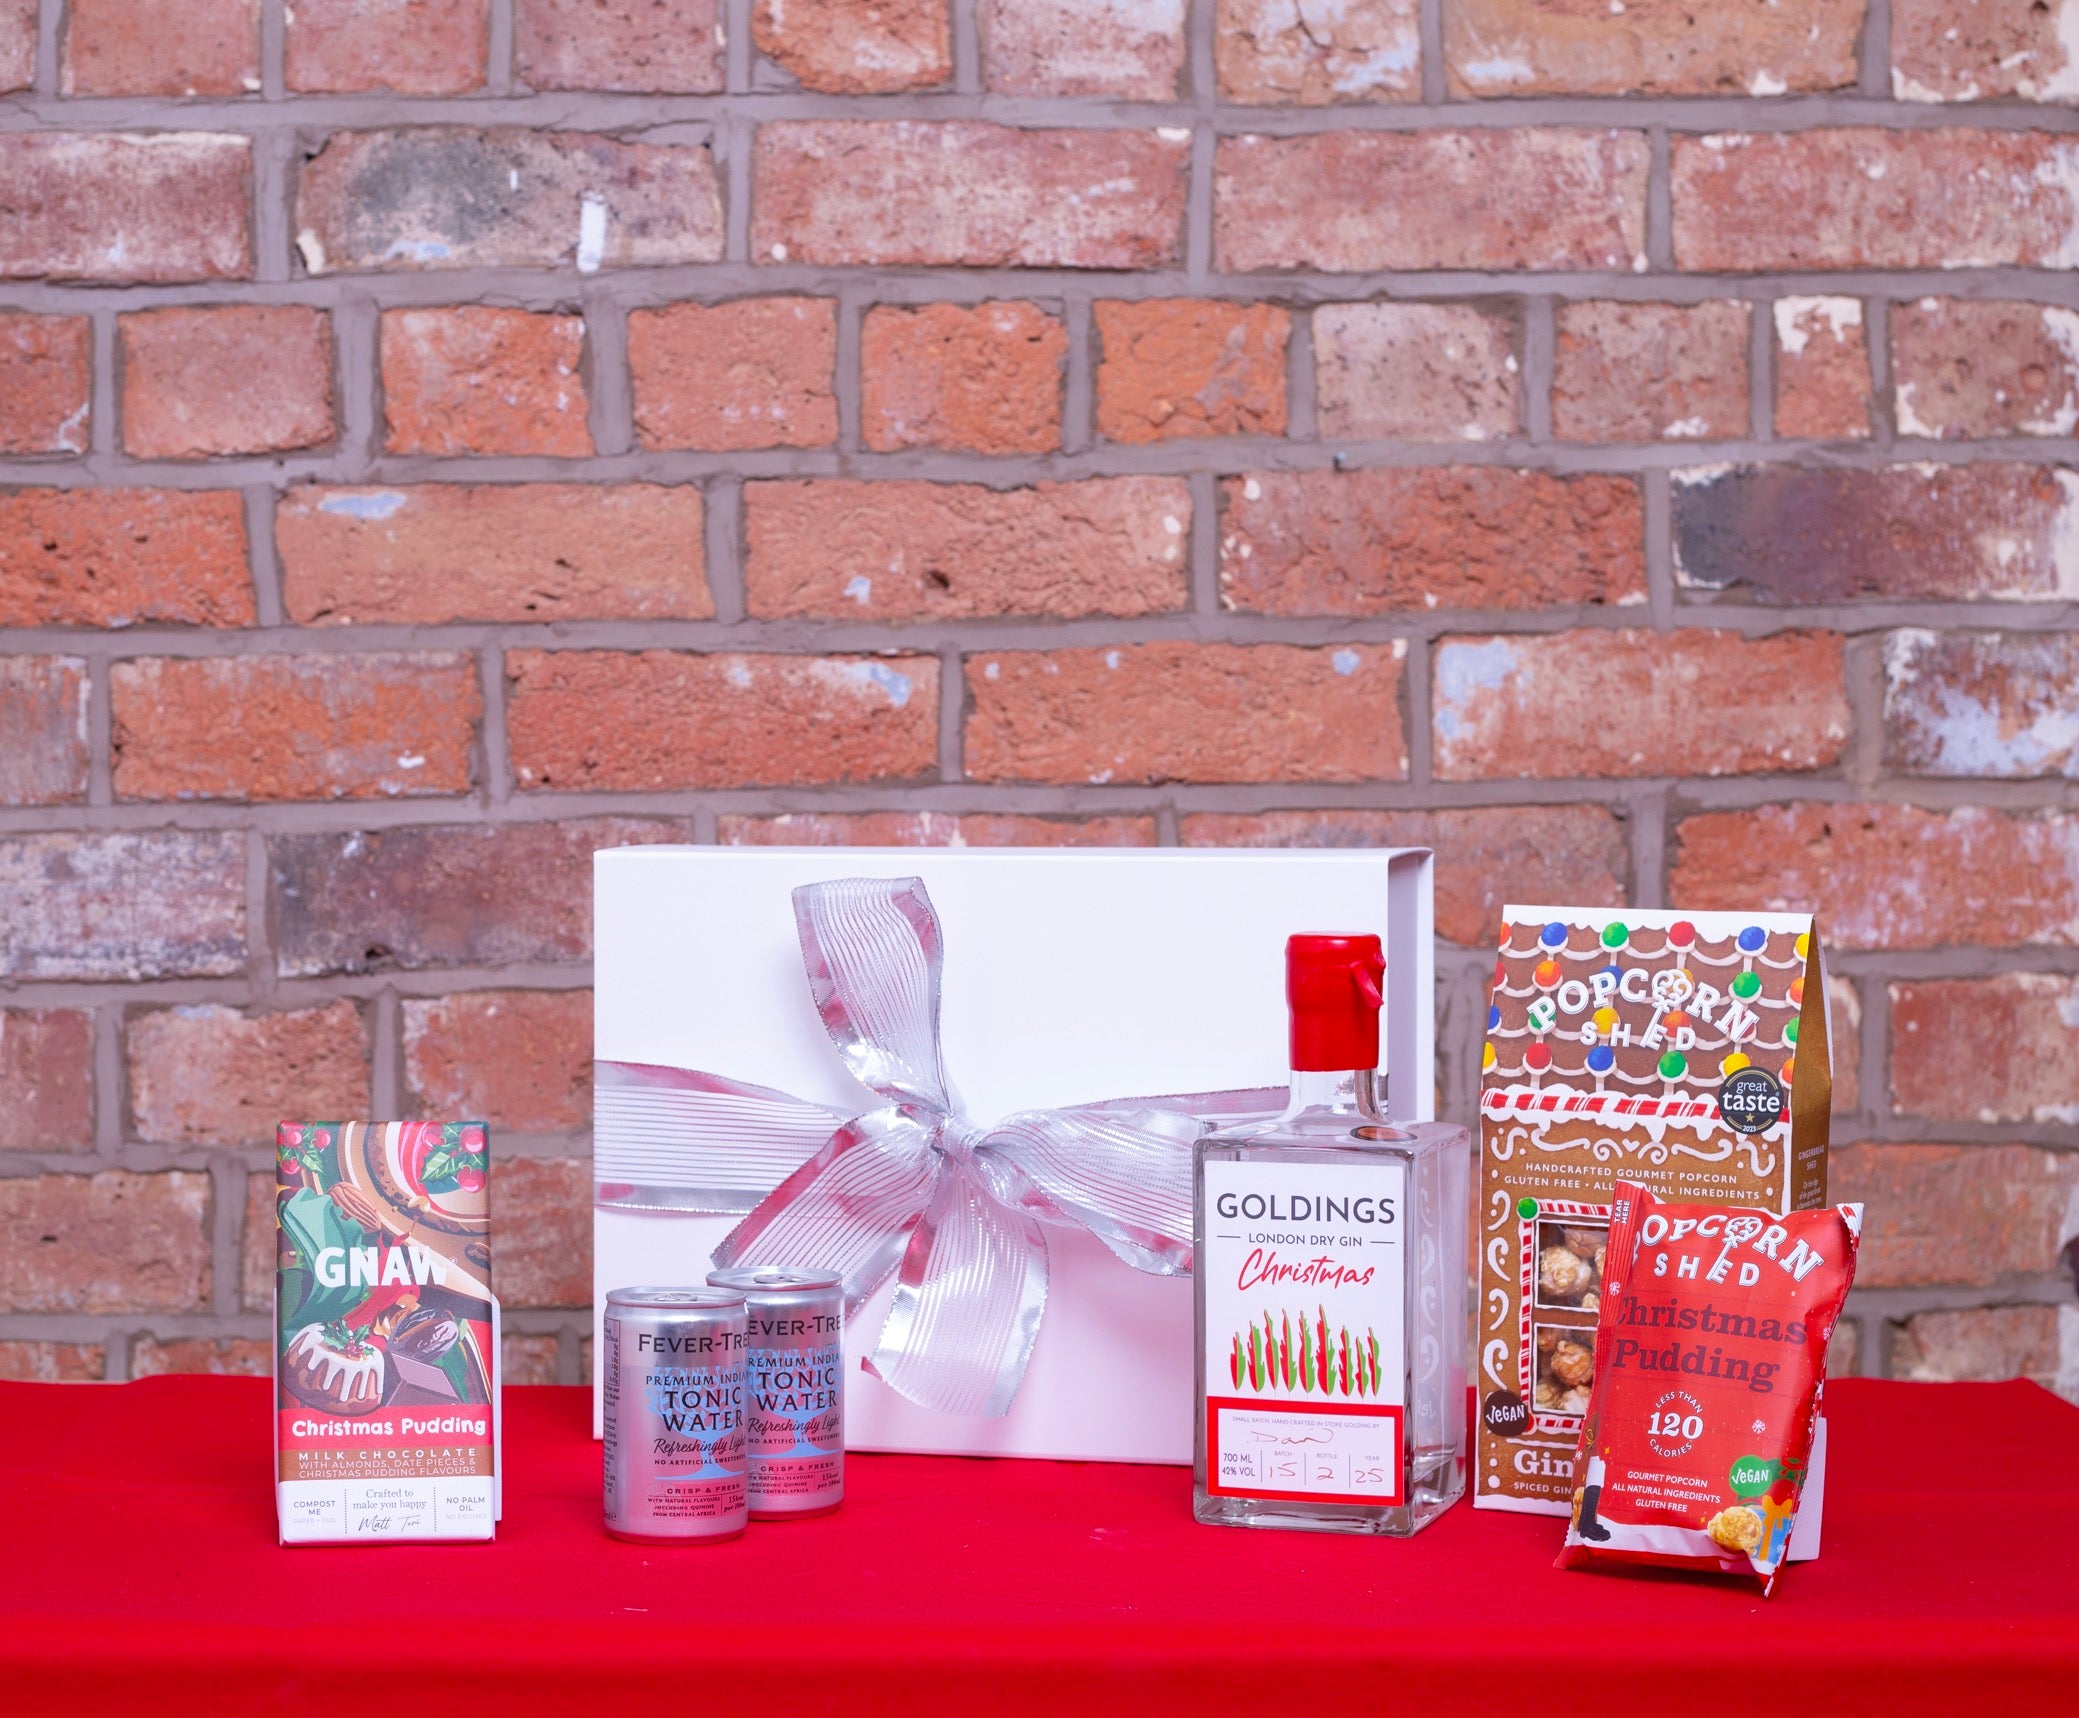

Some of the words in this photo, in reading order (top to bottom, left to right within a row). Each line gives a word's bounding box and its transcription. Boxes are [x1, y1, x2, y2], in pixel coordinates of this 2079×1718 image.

[1526, 967, 1760, 1044] POPCORN
[1580, 1020, 1697, 1051] SHED
[1736, 1080, 1767, 1095] great
[1722, 1091, 1780, 1113] taste
[1742, 1124, 1757, 1133] 2023
[1526, 1163, 1612, 1176] HANDCRAFTED
[1616, 1167, 1674, 1180] GOURMET
[1679, 1172, 1737, 1184] POPCORN
[1504, 1176, 1549, 1186] GLUTEN
[1554, 1179, 1580, 1189] FREE
[1593, 1182, 1614, 1191] ALL
[1679, 1187, 1760, 1200] INGREDIENTS
[1216, 1193, 1396, 1225] GOLDINGS
[1614, 1200, 1623, 1223] TEAR
[1621, 1200, 1630, 1224] HERE
[1249, 1233, 1305, 1245] LONDON
[1310, 1235, 1335, 1246] DRY
[1339, 1236, 1362, 1247] GIN
[1633, 1214, 1824, 1282] OPCORN
[315, 1246, 447, 1288] GNAW
[1238, 1248, 1375, 1291] Christmas
[1654, 1252, 1760, 1287] SHED
[638, 1332, 750, 1353] FEVER-TRE
[748, 1357, 806, 1367] REMIUM
[1612, 1339, 1780, 1393] Pudding
[646, 1375, 714, 1386] PREMIUM
[758, 1368, 834, 1389] TONIC
[664, 1386, 741, 1409] TONIC
[756, 1391, 837, 1411] WATER
[1656, 1392, 1675, 1408] LESS
[1679, 1391, 1703, 1413] THAN
[292, 1420, 394, 1437] Christmas
[401, 1417, 486, 1436] Pudding
[662, 1409, 743, 1432] WATER
[748, 1417, 820, 1436] Refreshingly
[1648, 1412, 1704, 1440] 120
[299, 1451, 345, 1460] MILK
[359, 1448, 476, 1459] CHOCOLATE
[654, 1437, 728, 1456] Refreshingly
[1650, 1439, 1692, 1457] CALORIES
[299, 1461, 328, 1469] WITH
[332, 1460, 390, 1469] ALMONDS,
[394, 1459, 422, 1468] DATE
[427, 1458, 465, 1467] PIECES
[469, 1457, 476, 1465] &
[669, 1458, 712, 1466] ARTIFICIAL
[808, 1462, 834, 1470] FRESH
[1223, 1453, 1237, 1462] 700
[1240, 1454, 1252, 1463] ML
[299, 1470, 361, 1478] CHRISTMAS
[365, 1468, 416, 1477] PUDDING
[420, 1466, 476, 1475] FLAVOURS
[1222, 1467, 1237, 1475] 42%
[1239, 1468, 1255, 1476] VOL
[1316, 1467, 1334, 1480] 2
[1355, 1468, 1384, 1483] 25
[1628, 1471, 1665, 1482] GOURMET
[1666, 1475, 1708, 1487] POPCORN
[365, 1489, 401, 1498] Crafted
[404, 1490, 414, 1498] to
[715, 1484, 740, 1492] FRESH
[1514, 1482, 1549, 1492] SPICED
[1612, 1483, 1625, 1491] ALL
[1627, 1485, 1662, 1495] NATURAL
[1664, 1489, 1721, 1503] INGREDIENTS
[353, 1500, 378, 1509] make
[380, 1502, 397, 1510] you
[400, 1500, 427, 1510] happy
[462, 1496, 486, 1504] PALM
[1636, 1499, 1666, 1510] GLUTEN
[1668, 1502, 1687, 1512] FREE
